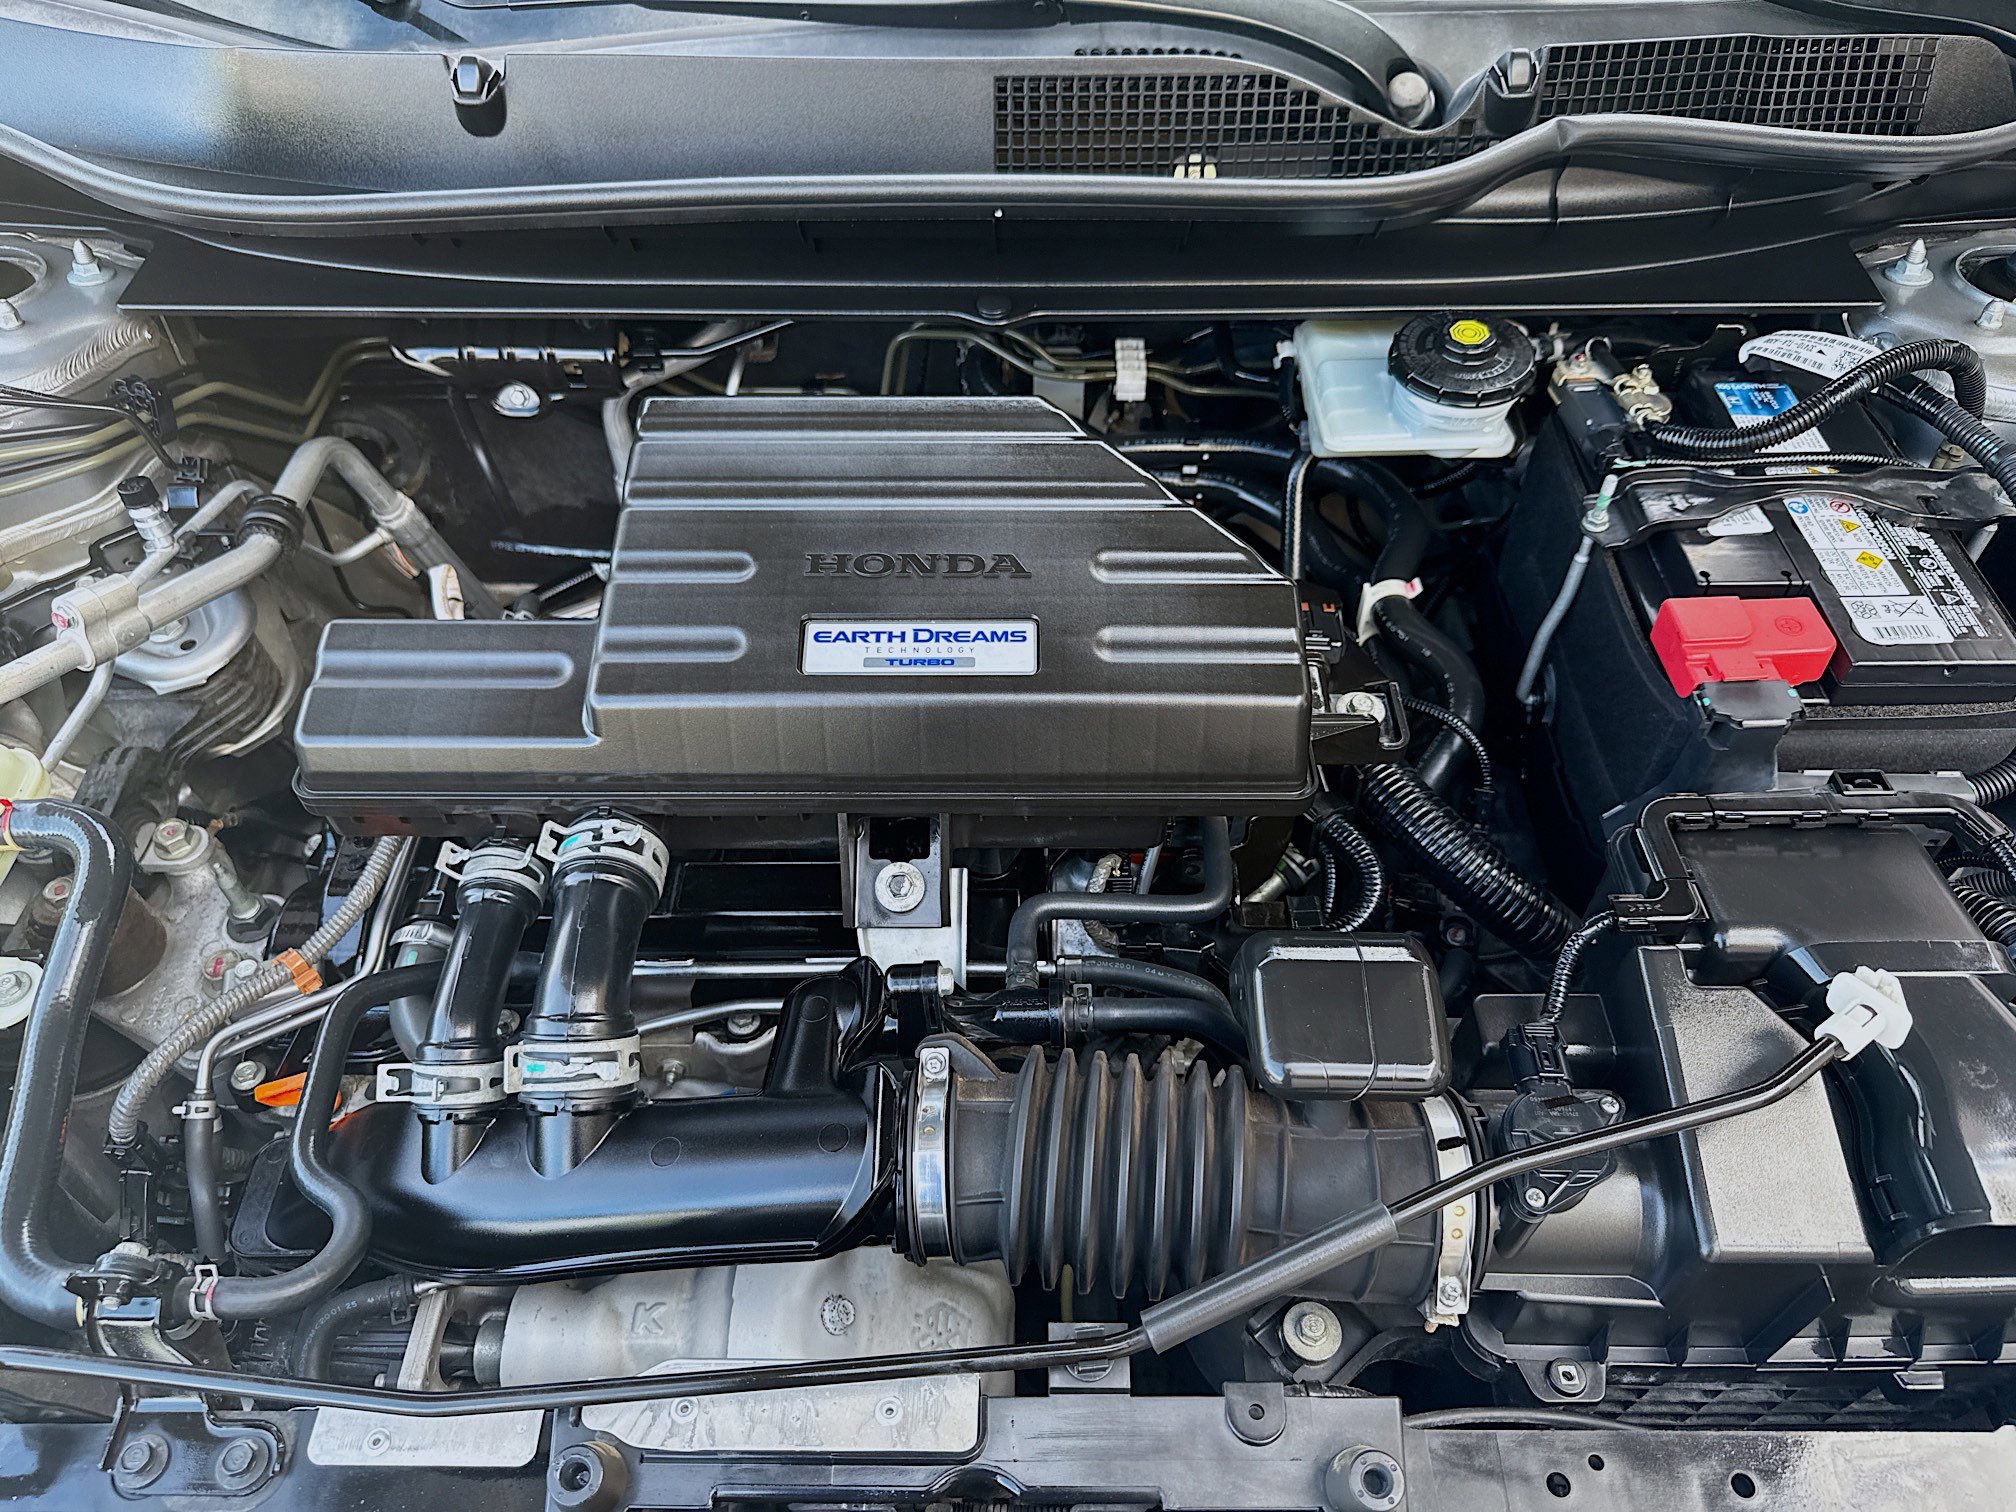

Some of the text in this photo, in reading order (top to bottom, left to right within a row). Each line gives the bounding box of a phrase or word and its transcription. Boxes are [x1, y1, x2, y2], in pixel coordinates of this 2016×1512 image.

[1852, 504, 1898, 560] NGER/POISON
[804, 553, 1032, 578] HONDA
[1926, 537, 1980, 609] DANGER/POISON
[813, 628, 1027, 643] EARTH DREAMS
[885, 658, 955, 666] TURBO
[345, 1300, 358, 1310] 25
